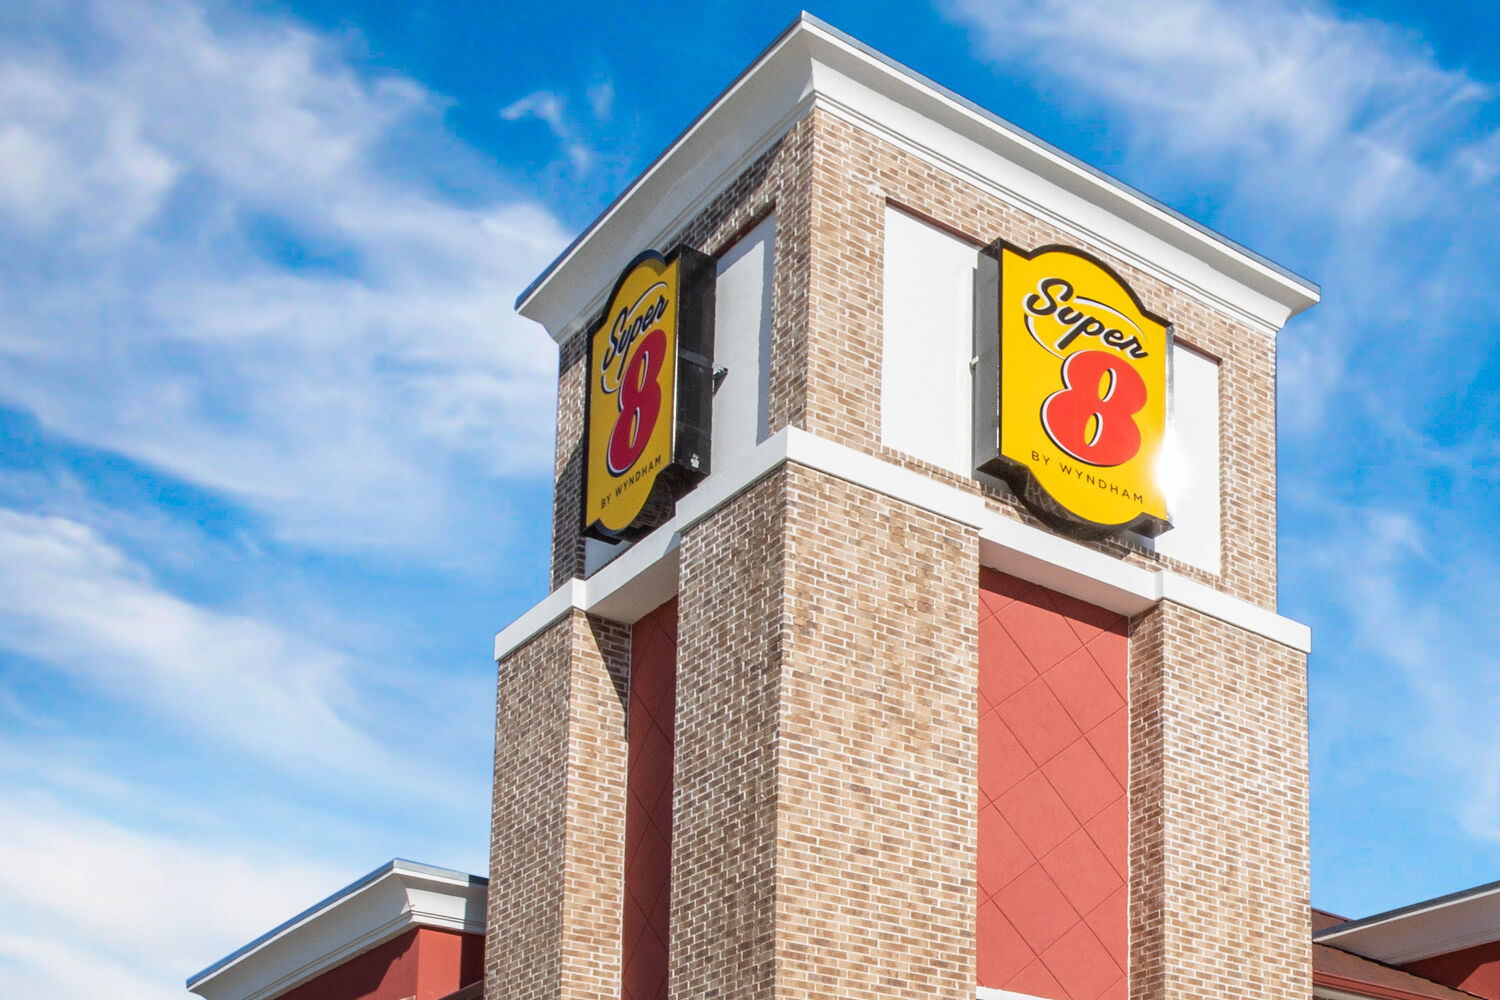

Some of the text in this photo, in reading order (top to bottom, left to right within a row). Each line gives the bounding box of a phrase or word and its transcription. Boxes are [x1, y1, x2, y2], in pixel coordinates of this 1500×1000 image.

[601, 294, 669, 383] Super
[1022, 276, 1149, 360] Super
[606, 328, 668, 478] 8
[1040, 349, 1148, 468] 8
[601, 454, 662, 509] BY WYNDHAM
[1031, 450, 1144, 505] BY WYNDHAM
